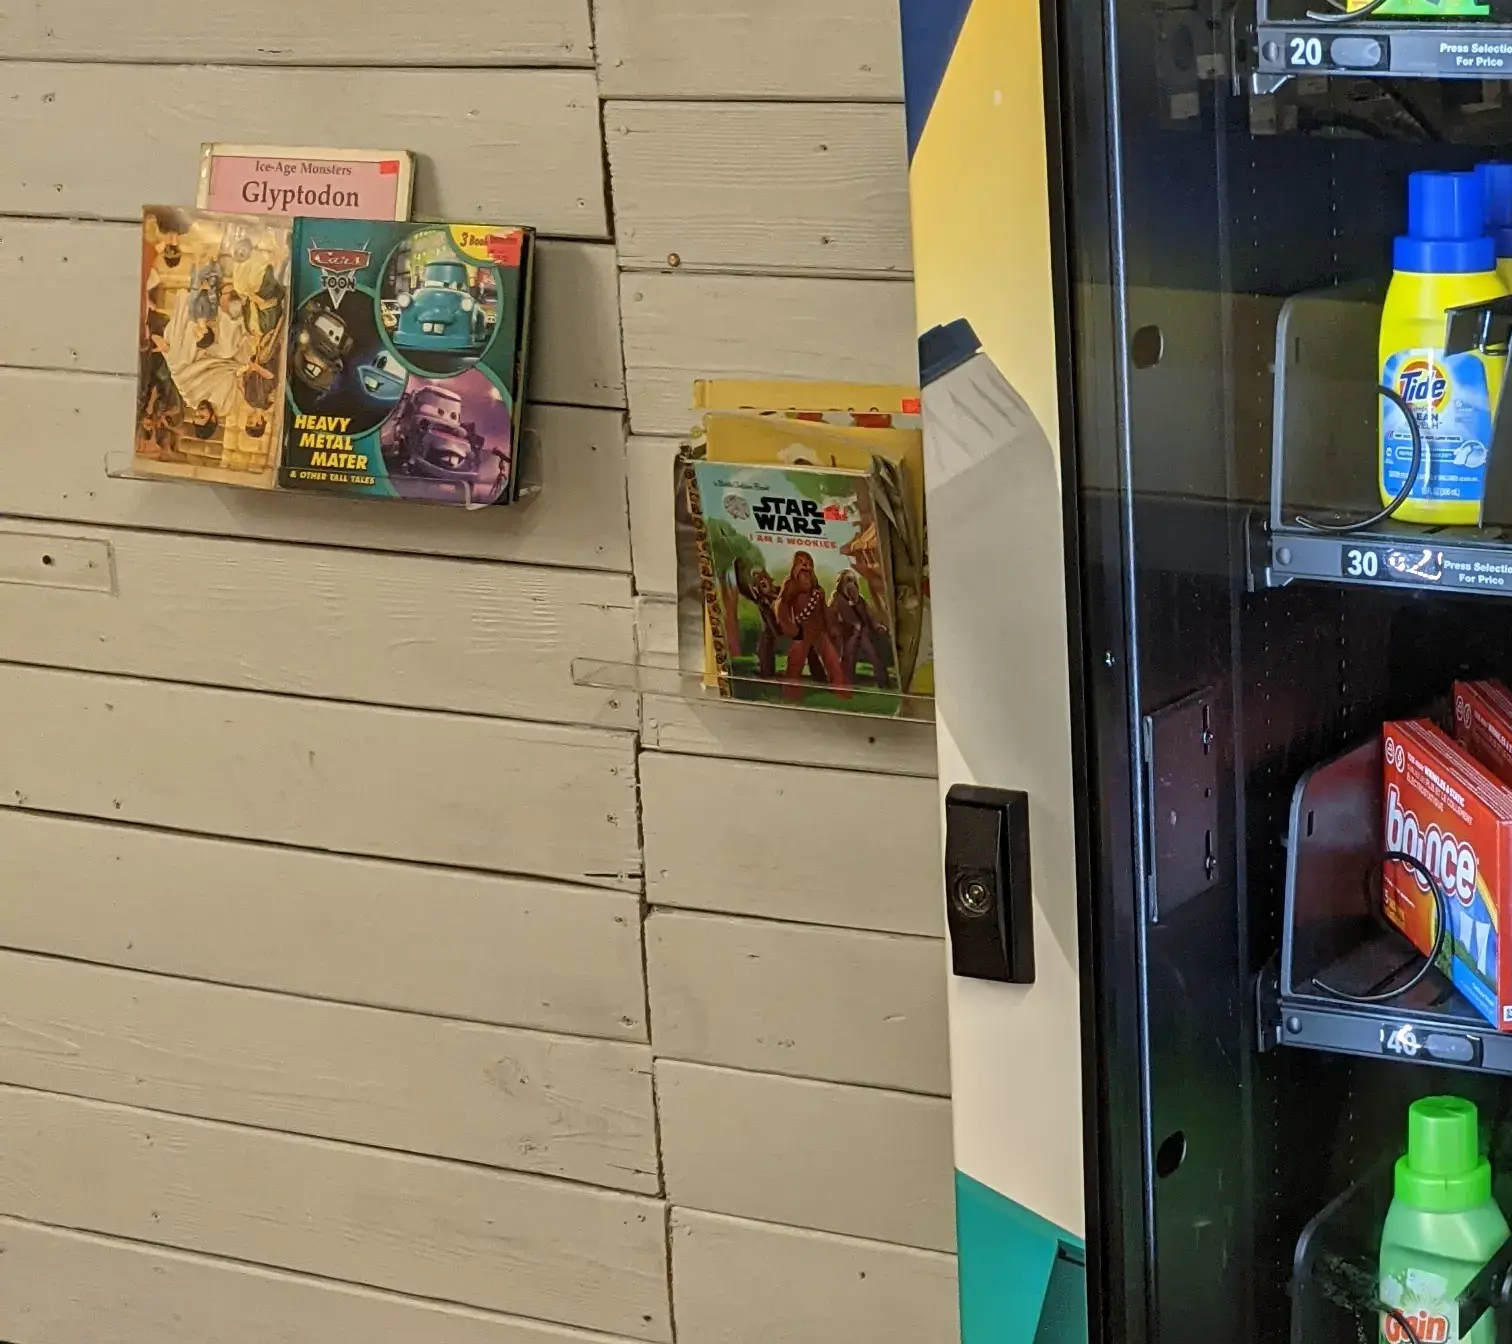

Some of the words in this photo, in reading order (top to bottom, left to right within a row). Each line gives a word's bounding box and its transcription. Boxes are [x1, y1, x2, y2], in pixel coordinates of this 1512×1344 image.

[1290, 37, 1322, 66] 20
[1439, 42, 1469, 54] Press
[1456, 56, 1475, 67] For
[1476, 56, 1504, 67] Price
[255, 160, 296, 176] Ice-Age
[300, 162, 352, 176] Monsters
[242, 180, 359, 212] Glyptodon
[460, 232, 468, 247] 3
[321, 276, 356, 289] TOON
[1400, 370, 1446, 403] Tide
[294, 414, 351, 432] HEAVY
[299, 432, 354, 451] METAL
[310, 451, 368, 470] MATER
[300, 471, 327, 480] OTHER
[330, 473, 348, 482] TALL
[350, 475, 376, 485] TALES
[752, 496, 824, 518] STAR
[754, 513, 826, 535] WARS
[1347, 550, 1378, 577] 30
[1386, 782, 1477, 907] bounce
